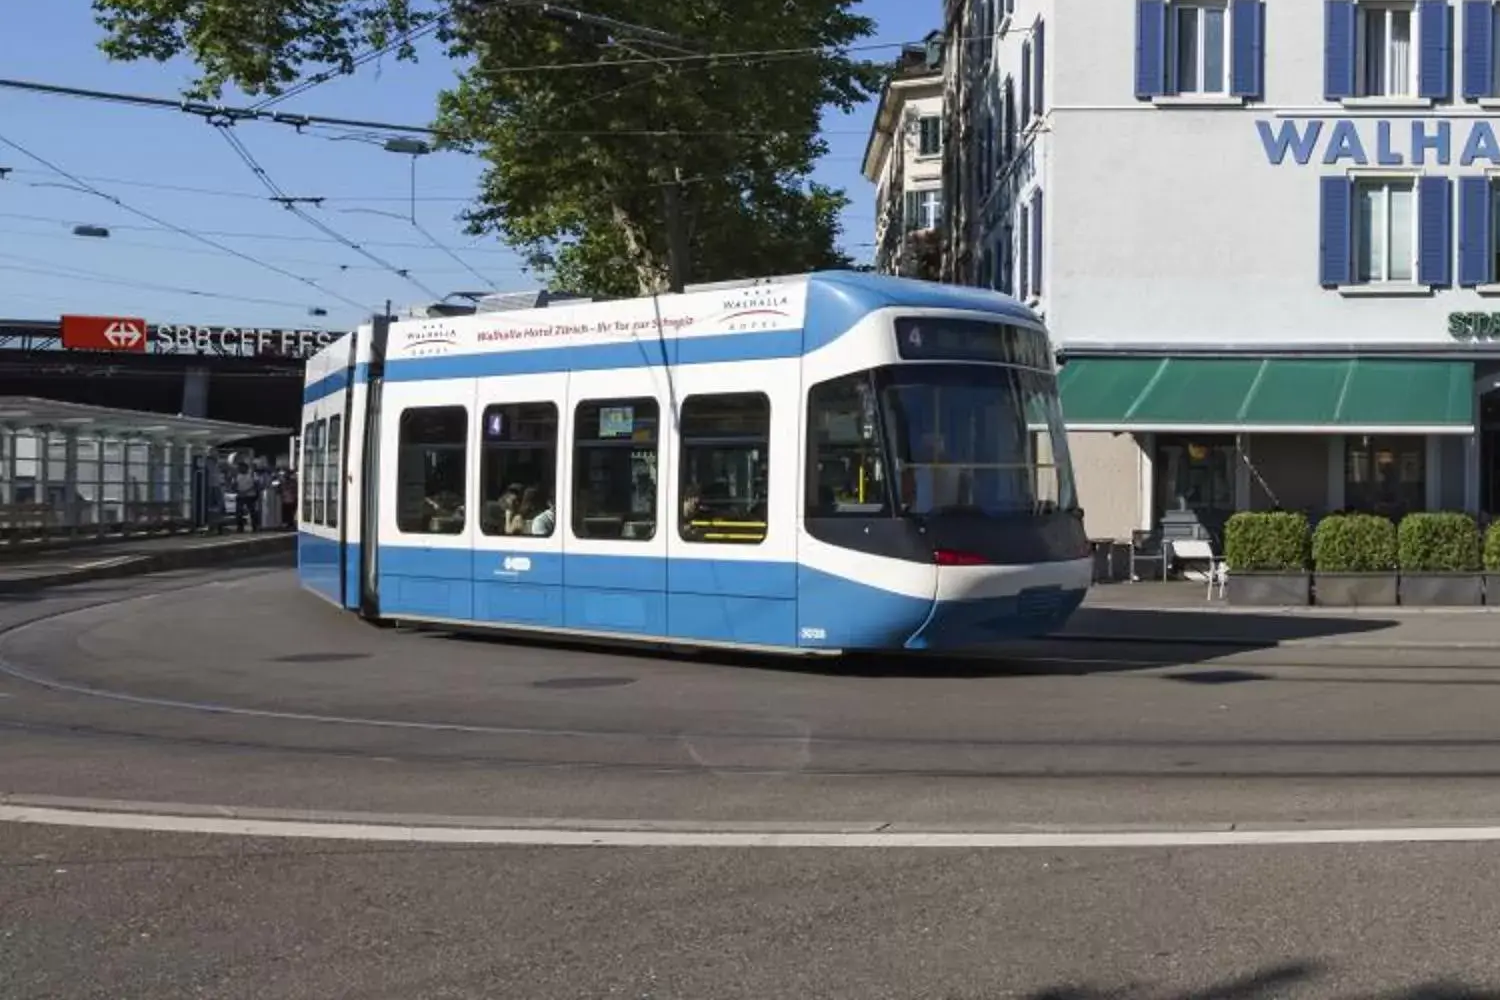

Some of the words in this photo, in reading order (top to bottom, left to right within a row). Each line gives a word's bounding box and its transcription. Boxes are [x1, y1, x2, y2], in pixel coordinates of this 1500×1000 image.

[157, 324, 211, 351] SBB
[220, 327, 273, 353] CFF
[282, 330, 331, 355] FFS
[909, 326, 922, 347] 4
